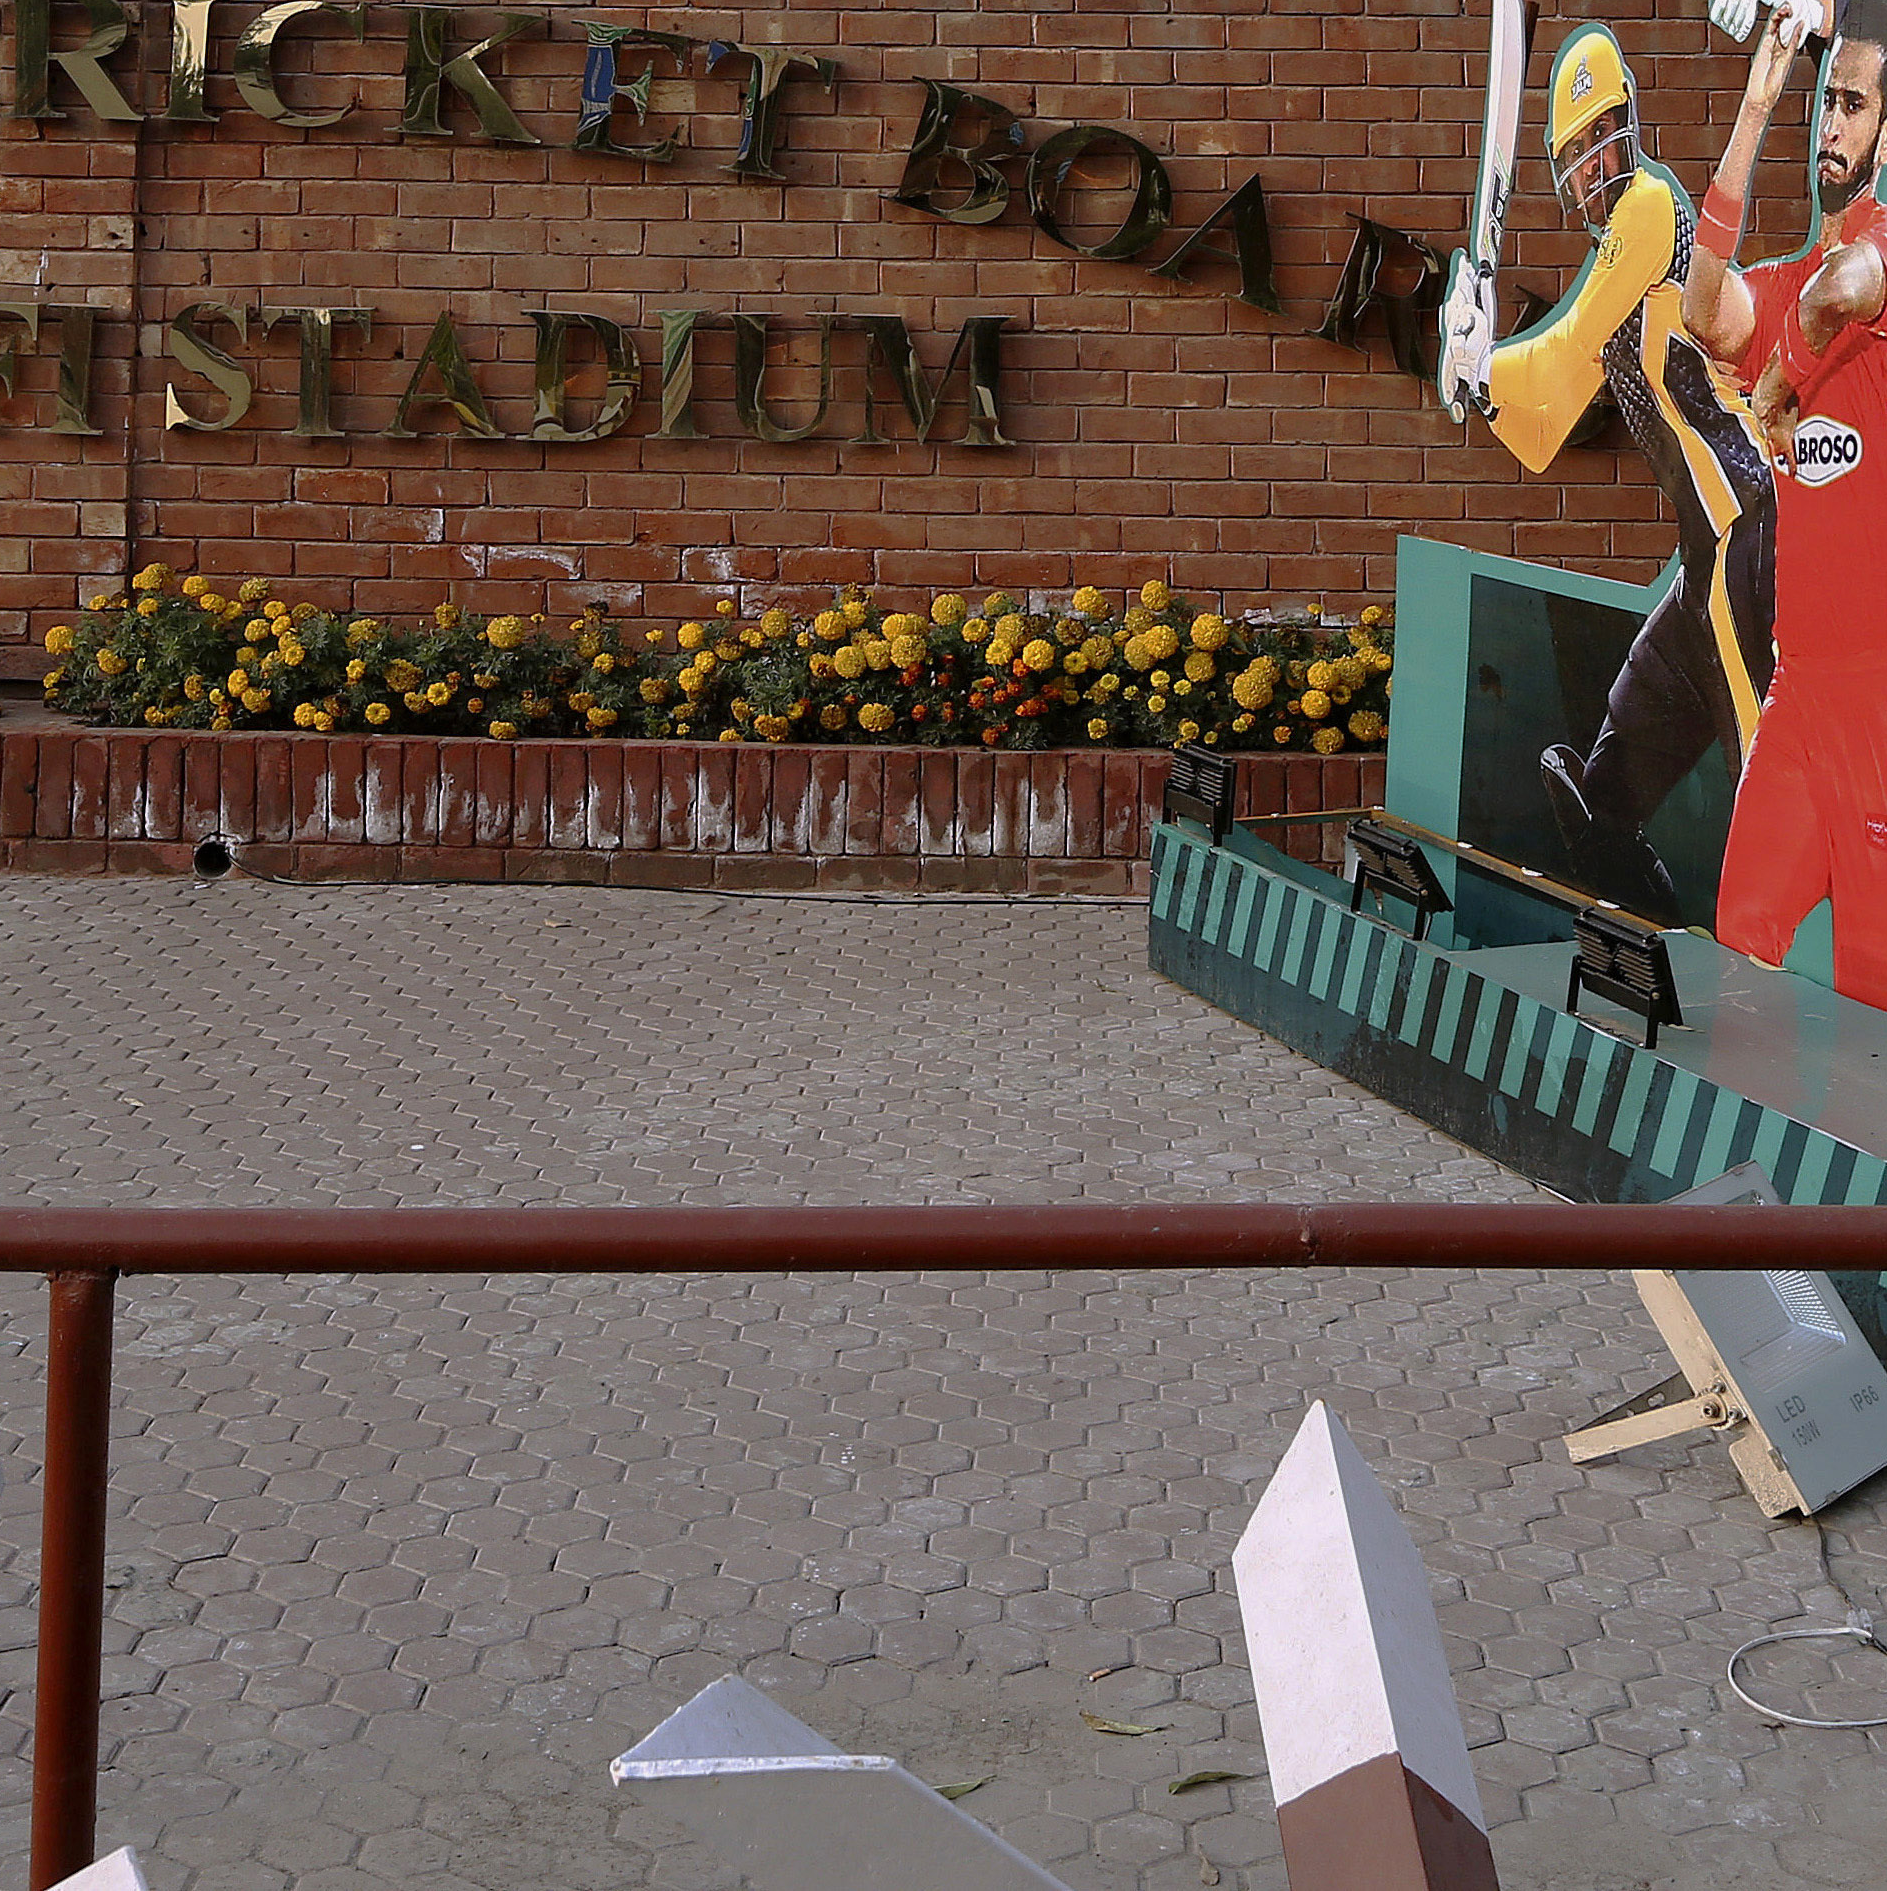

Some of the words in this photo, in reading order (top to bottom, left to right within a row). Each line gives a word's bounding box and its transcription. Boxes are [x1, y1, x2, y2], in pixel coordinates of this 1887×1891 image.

[881, 74, 1613, 442] BOAR
[162, 300, 1019, 448] STADIUM
[1777, 433, 1859, 466] BROSO
[1775, 1394, 1807, 1424] LED
[1849, 1385, 1880, 1414] IP66
[1791, 1419, 1822, 1448] 150W
